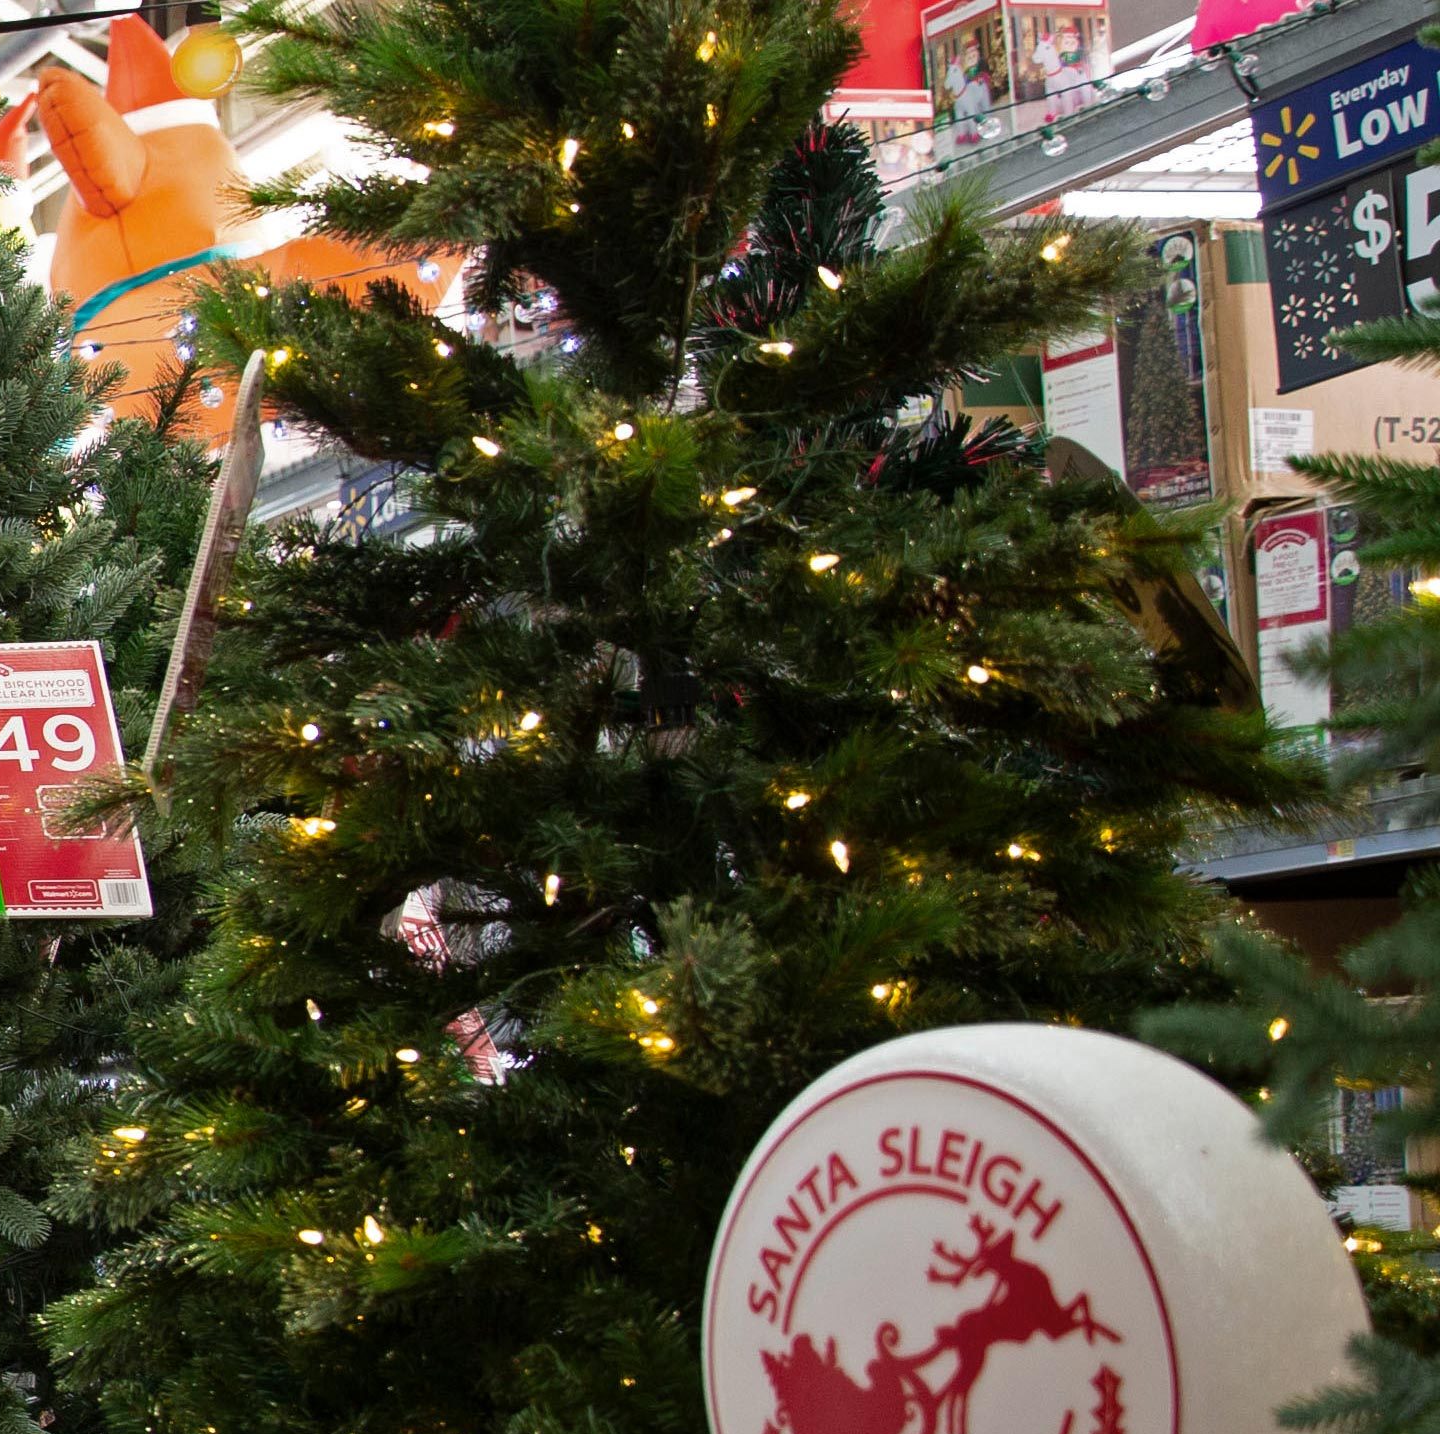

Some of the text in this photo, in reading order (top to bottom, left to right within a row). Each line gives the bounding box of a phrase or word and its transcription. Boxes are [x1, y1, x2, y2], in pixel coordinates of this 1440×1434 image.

[1330, 64, 1411, 111] Everyday
[4, 678, 86, 690] BIRCHWOOD
[40, 689, 86, 698] LIGHTS
[748, 1126, 1063, 1324] SANTA SLEIGH
